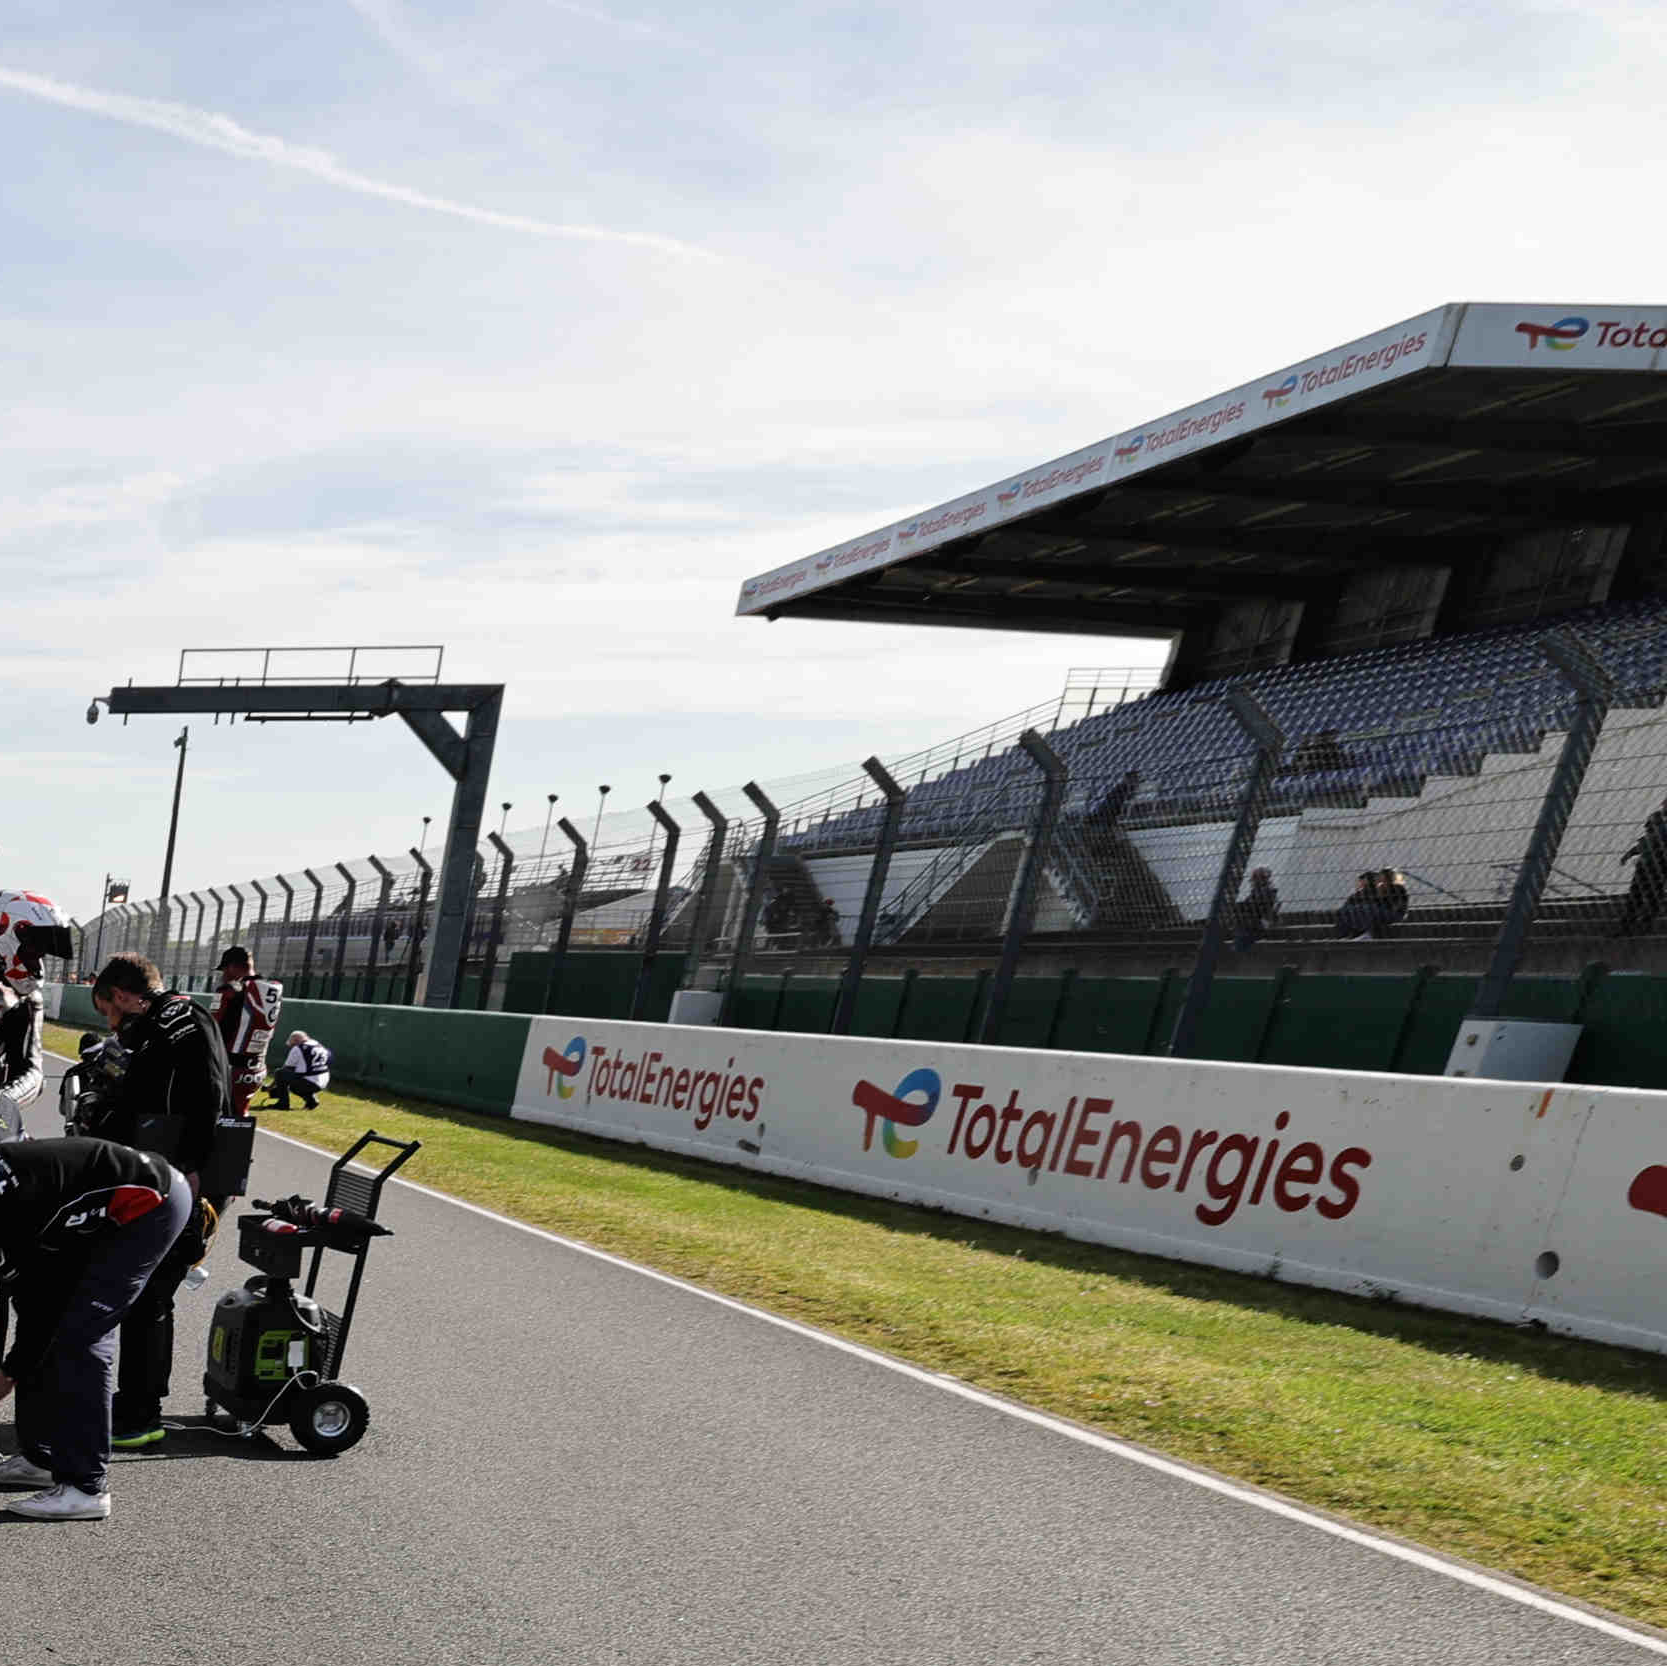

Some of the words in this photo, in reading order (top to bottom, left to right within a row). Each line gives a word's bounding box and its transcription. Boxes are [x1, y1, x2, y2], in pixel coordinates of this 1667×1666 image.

[1299, 331, 1428, 395] TotalEnergies
[1144, 400, 1246, 454] TotalEnergies
[587, 1045, 765, 1131] TotalEnergies
[947, 1083, 1372, 1227] TotalEnergies
